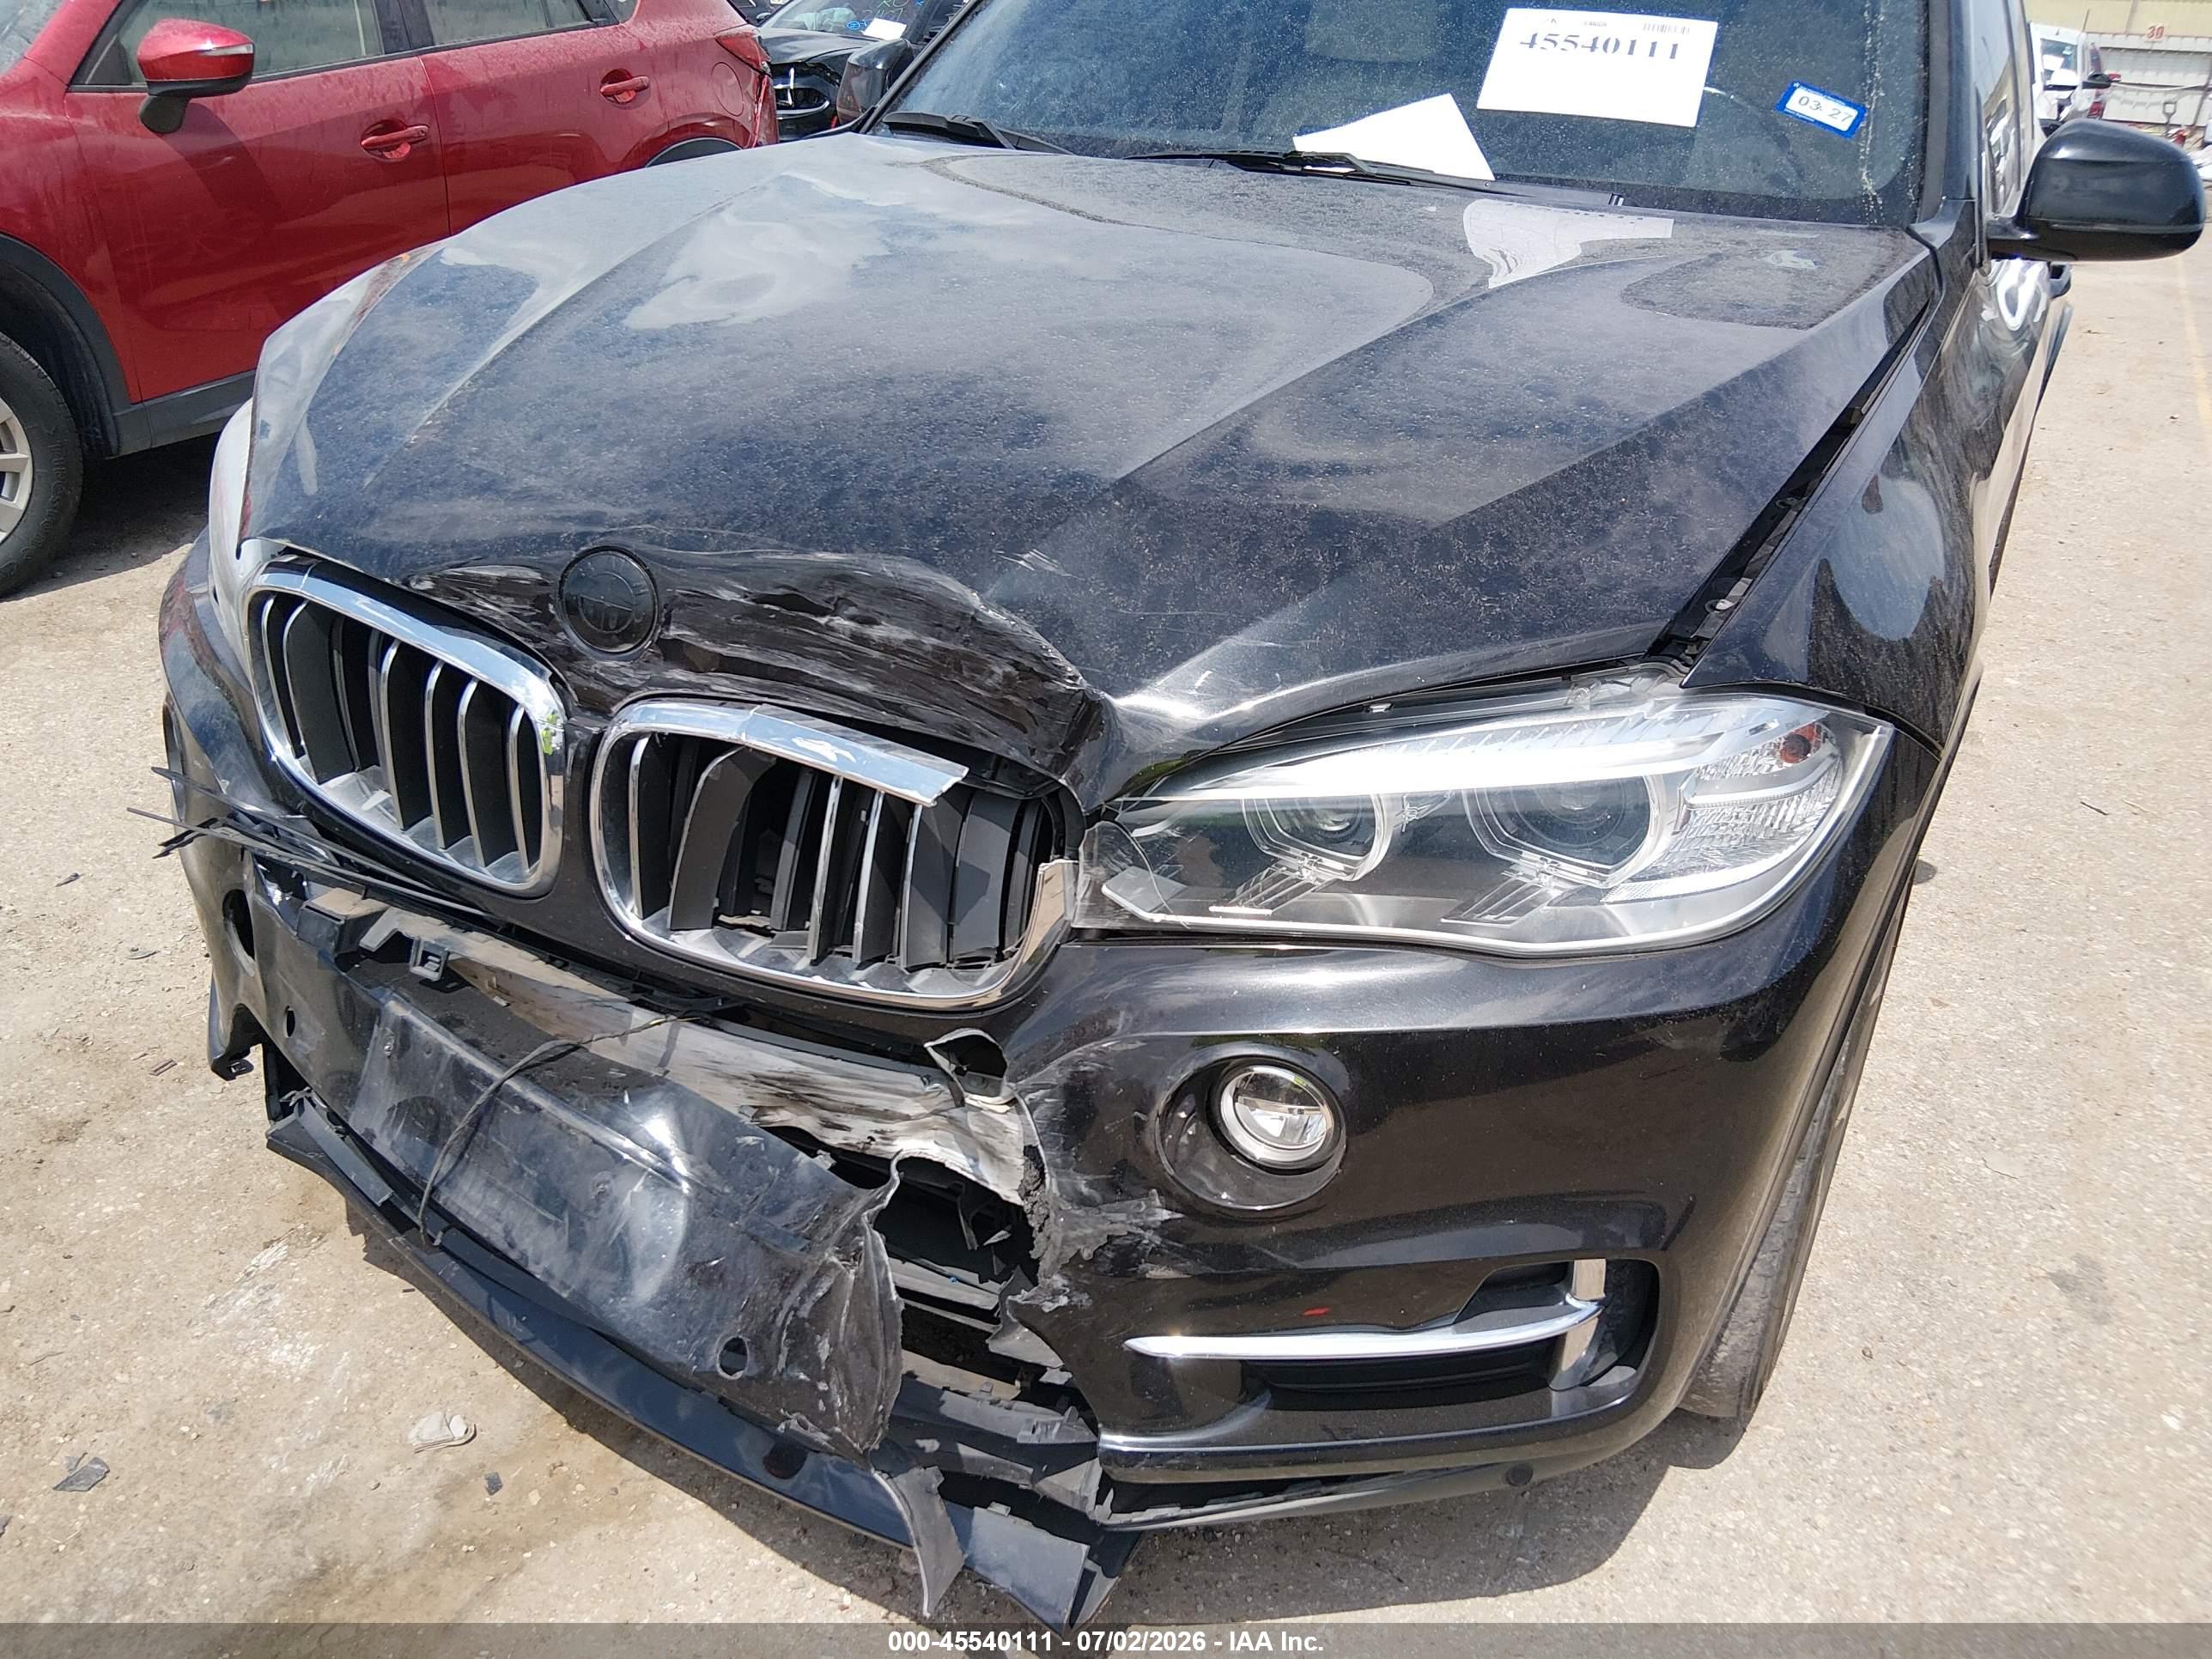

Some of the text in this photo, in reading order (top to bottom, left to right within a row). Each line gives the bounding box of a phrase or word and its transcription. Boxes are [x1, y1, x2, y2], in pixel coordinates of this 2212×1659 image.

[2147, 26, 2165, 40] 30
[1519, 32, 1679, 59] 45540111
[1827, 108, 1854, 122] 27
